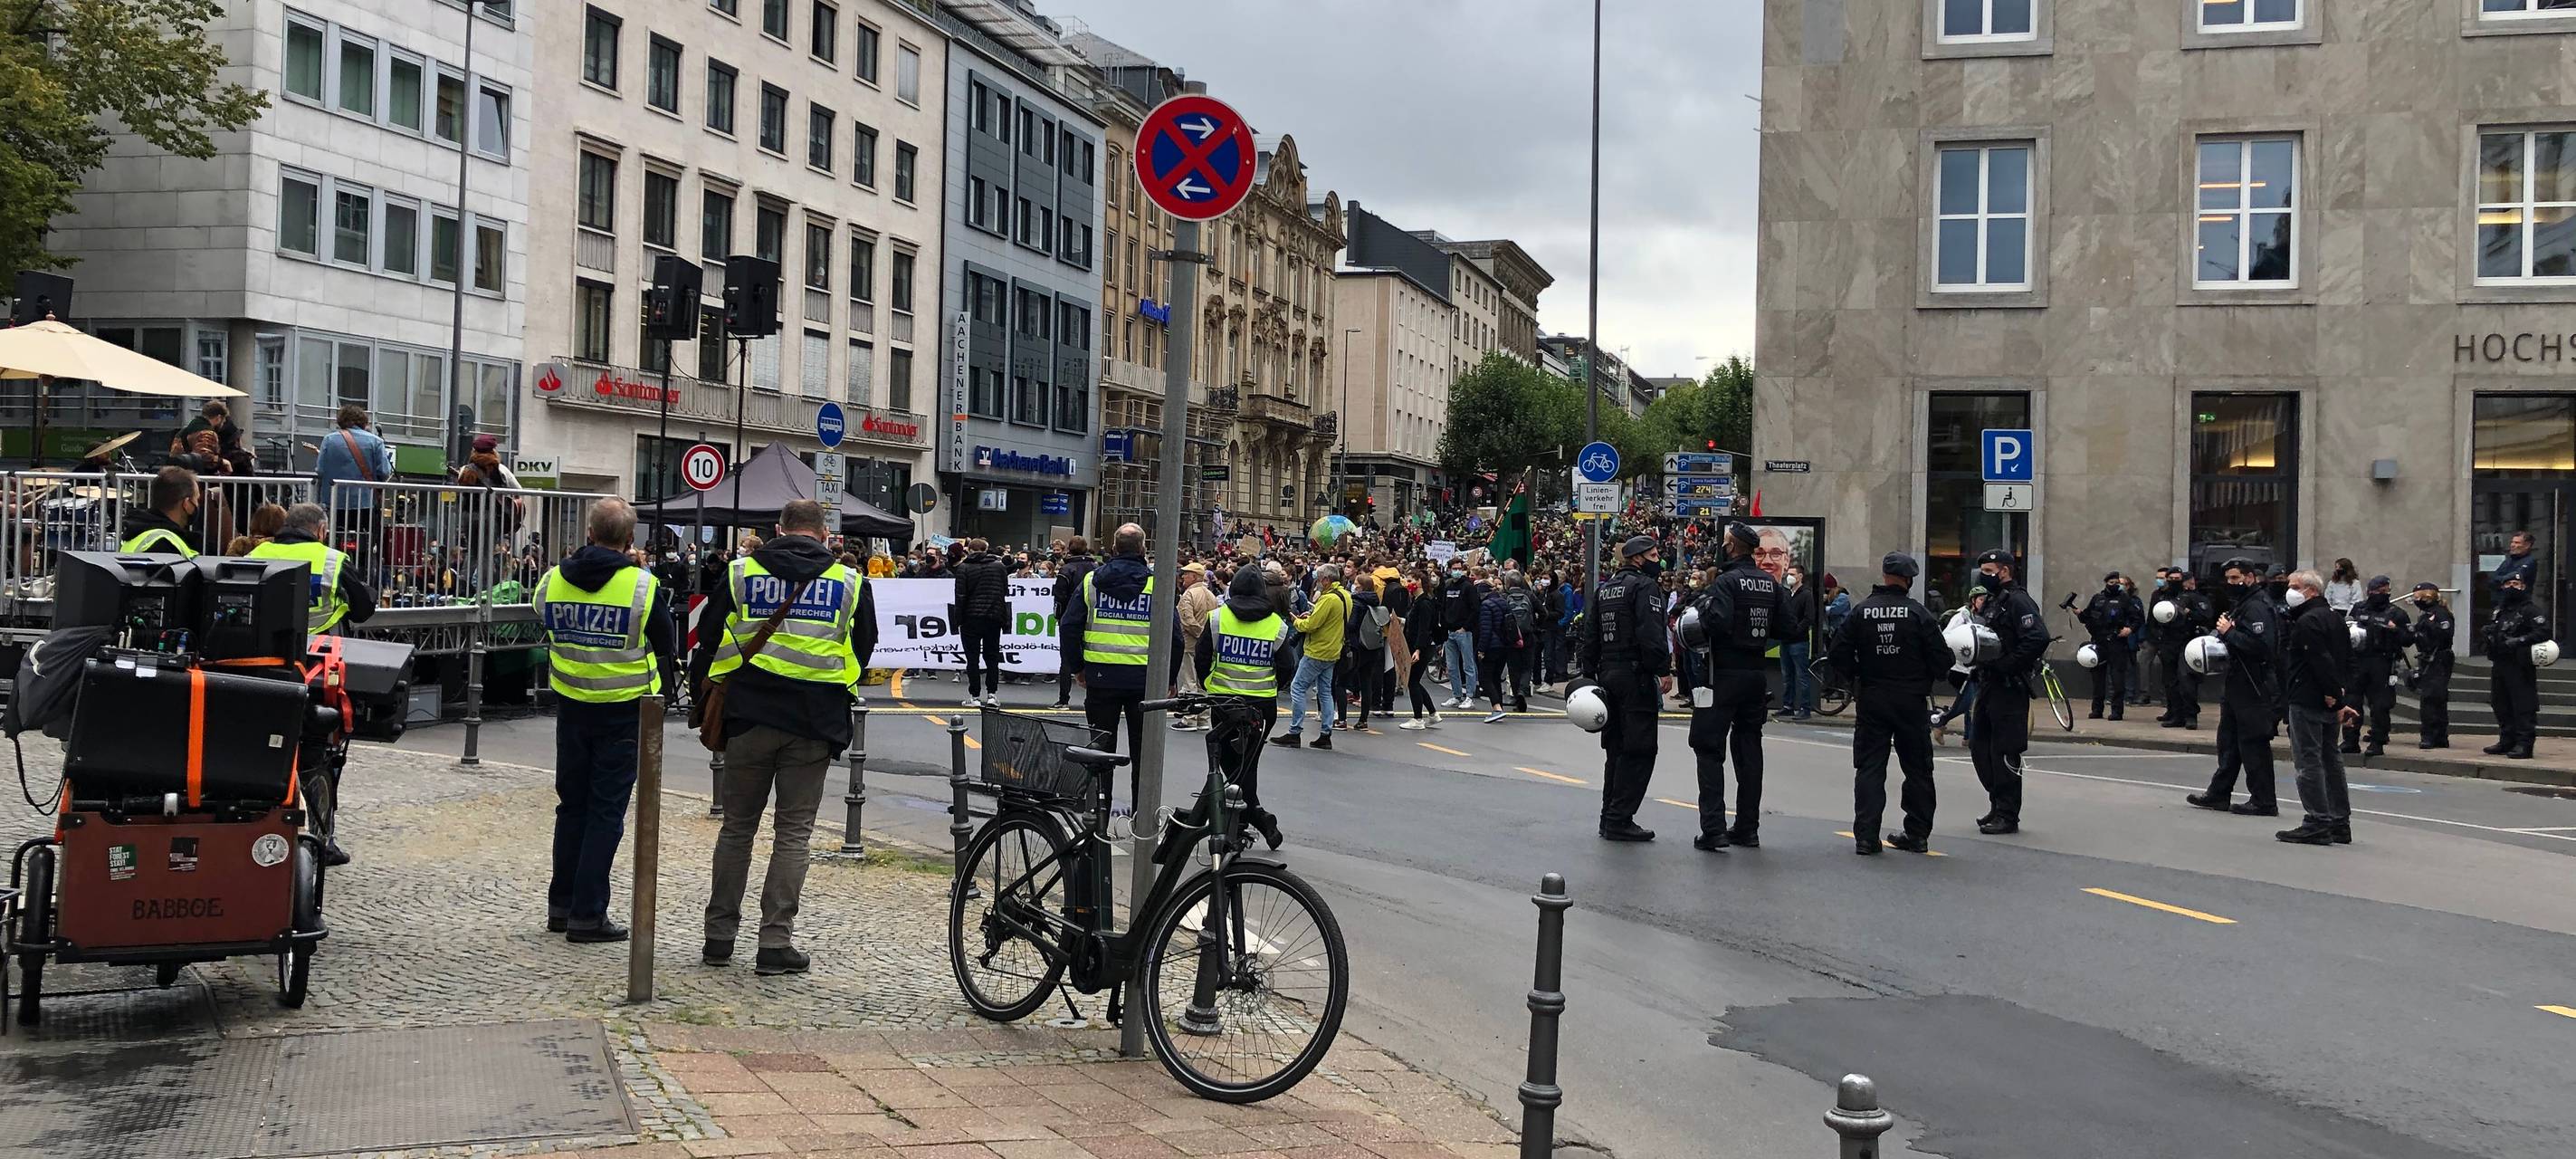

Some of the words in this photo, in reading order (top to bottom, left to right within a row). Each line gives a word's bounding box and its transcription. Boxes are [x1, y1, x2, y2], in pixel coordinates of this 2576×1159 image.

[955, 313, 966, 414] AACHENER
[873, 417, 918, 437] Santander
[953, 422, 963, 471] BANK
[1994, 436, 2021, 474] P
[992, 447, 1041, 473] Aachener
[1040, 455, 1067, 475] Bank
[517, 461, 552, 473] DKV
[693, 457, 713, 478] 10
[821, 482, 838, 493] TAXI
[1586, 486, 1613, 494] Linien-
[1695, 485, 1712, 493] 274
[1699, 507, 1710, 515] 21
[1740, 579, 1774, 593] POLIZEI
[750, 577, 834, 607] POLIZEI
[1598, 587, 1626, 600] POLIZEI
[551, 603, 622, 633] POLIZEI
[1098, 610, 1125, 619] SOCIAL
[1126, 613, 1150, 621] MEDIA
[1601, 612, 1616, 622] NRW
[1751, 608, 1769, 617] NRW
[1864, 607, 1909, 618] POLIZEI
[1877, 623, 1895, 632] NRW
[1879, 634, 1894, 644] 117
[1222, 636, 1274, 658] POLIZEI
[1876, 645, 1901, 655] FüGr
[1221, 656, 1247, 665] SOCIAL
[1249, 658, 1271, 666] MEDIA
[110, 852, 129, 860] FOREST
[131, 897, 224, 920] BABBOE
